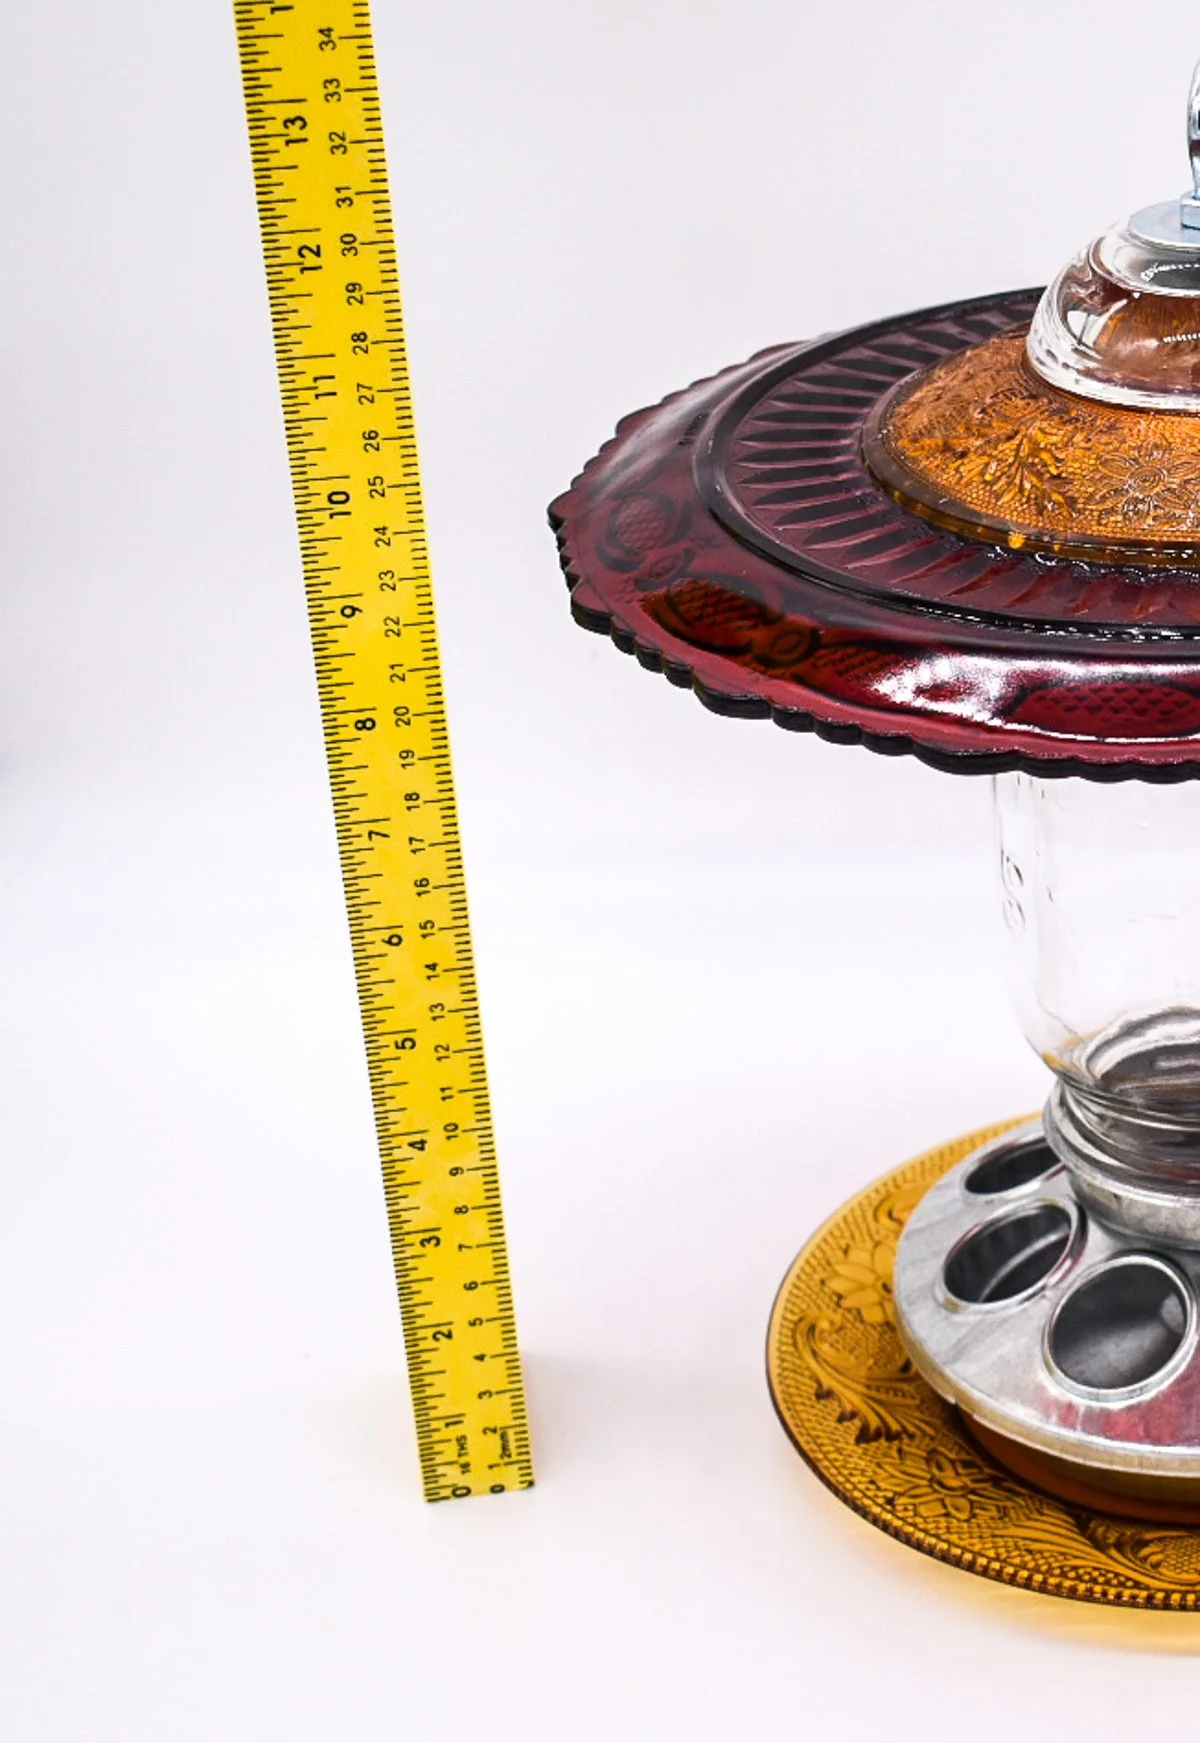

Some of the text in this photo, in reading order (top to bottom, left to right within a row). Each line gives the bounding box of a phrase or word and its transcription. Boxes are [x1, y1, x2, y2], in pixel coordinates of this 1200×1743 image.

[318, 27, 337, 51] 34
[324, 78, 341, 103] 33
[283, 115, 308, 147] 13
[329, 131, 348, 155] 32
[335, 186, 353, 208] 31
[340, 233, 358, 257] 30
[298, 244, 322, 274] 12
[345, 282, 364, 306] 29
[351, 331, 369, 355] 28
[312, 375, 337, 400] 11
[357, 383, 375, 405] 27
[362, 430, 380, 453] 26
[368, 476, 386, 499] 25
[327, 491, 352, 519] 10
[373, 526, 391, 547] 24
[378, 570, 397, 592] 23
[340, 605, 363, 618] 9
[384, 616, 401, 638] 22
[389, 663, 406, 683] 21
[354, 717, 376, 731] 8
[393, 706, 411, 728] 20
[399, 749, 415, 770] 19
[404, 792, 421, 812] 18
[368, 830, 391, 842] 7
[408, 836, 426, 855] 17
[414, 877, 431, 897] 16
[419, 920, 435, 940] 15
[381, 934, 403, 947] 6
[424, 962, 440, 981] 14
[429, 1002, 445, 1022] 13
[394, 1037, 417, 1051] 5
[434, 1044, 450, 1062] 12
[439, 1086, 455, 1102] 11
[443, 1122, 459, 1141] 10
[407, 1138, 428, 1152] 4
[449, 1166, 464, 1177] 9
[454, 1205, 469, 1215] 8
[419, 1235, 441, 1248] 3
[458, 1243, 473, 1252] 7
[463, 1280, 479, 1291] 6
[468, 1317, 483, 1328] 5
[432, 1328, 454, 1342] 2
[472, 1353, 487, 1362] 4
[478, 1389, 493, 1400] 3
[444, 1419, 464, 1429] 1
[482, 1426, 498, 1436] 2
[451, 1485, 472, 1499] 0
[489, 1484, 505, 1494] 0
